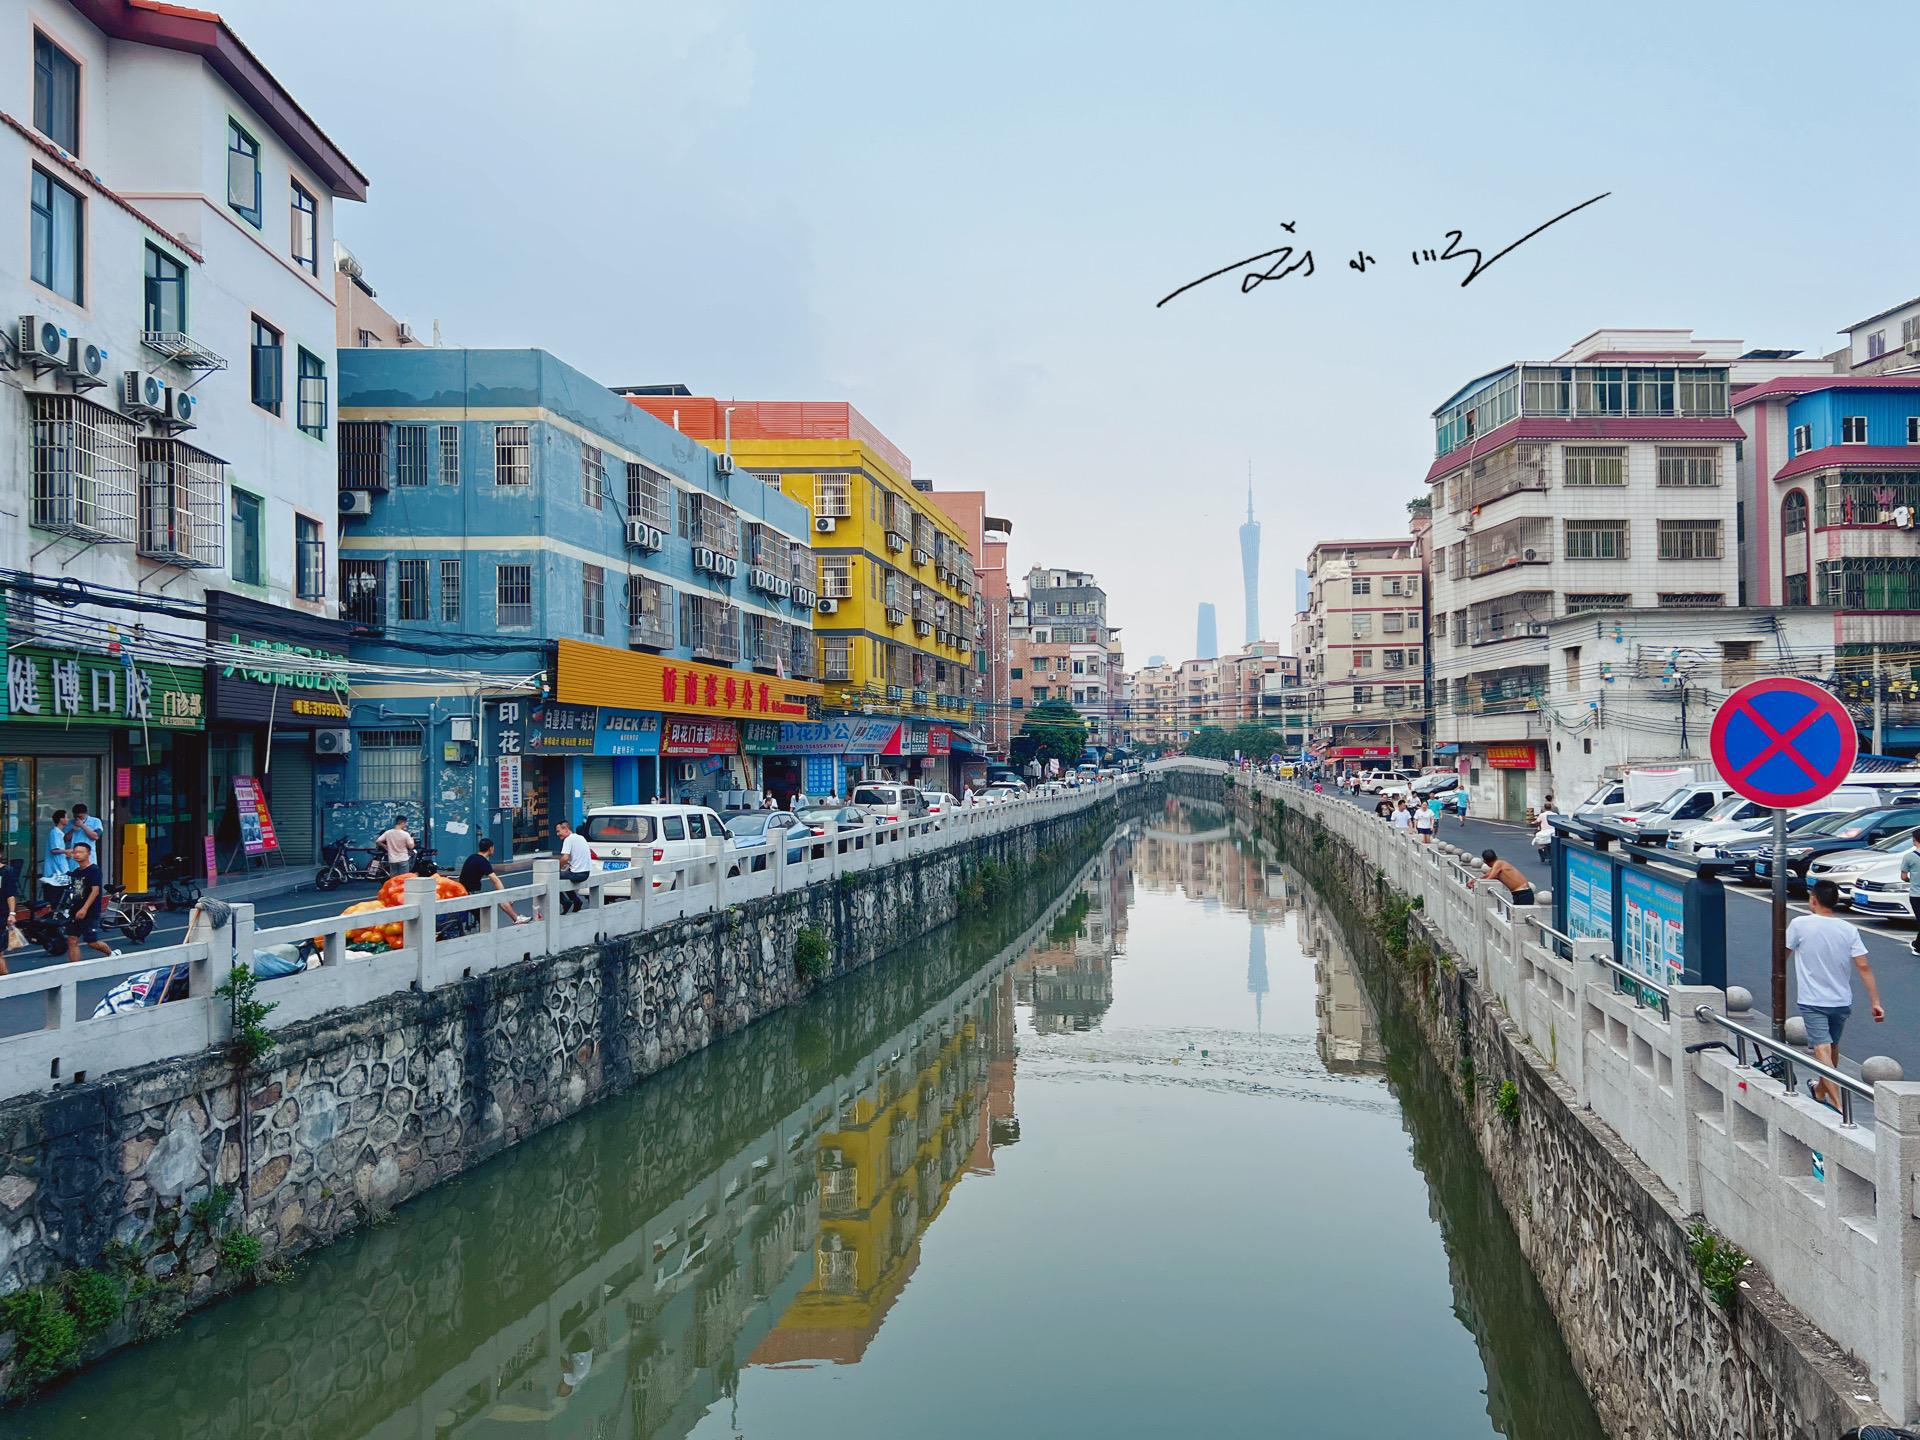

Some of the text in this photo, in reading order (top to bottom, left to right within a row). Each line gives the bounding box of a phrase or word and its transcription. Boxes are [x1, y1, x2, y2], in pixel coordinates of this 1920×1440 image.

[7, 655, 153, 720] 健博口腔
[163, 690, 202, 717] 门诊部
[498, 702, 520, 753] 印花
[545, 708, 595, 731] 白墨烫画一站式
[780, 722, 850, 741] 印花办公
[672, 723, 714, 744] 印花门市部
